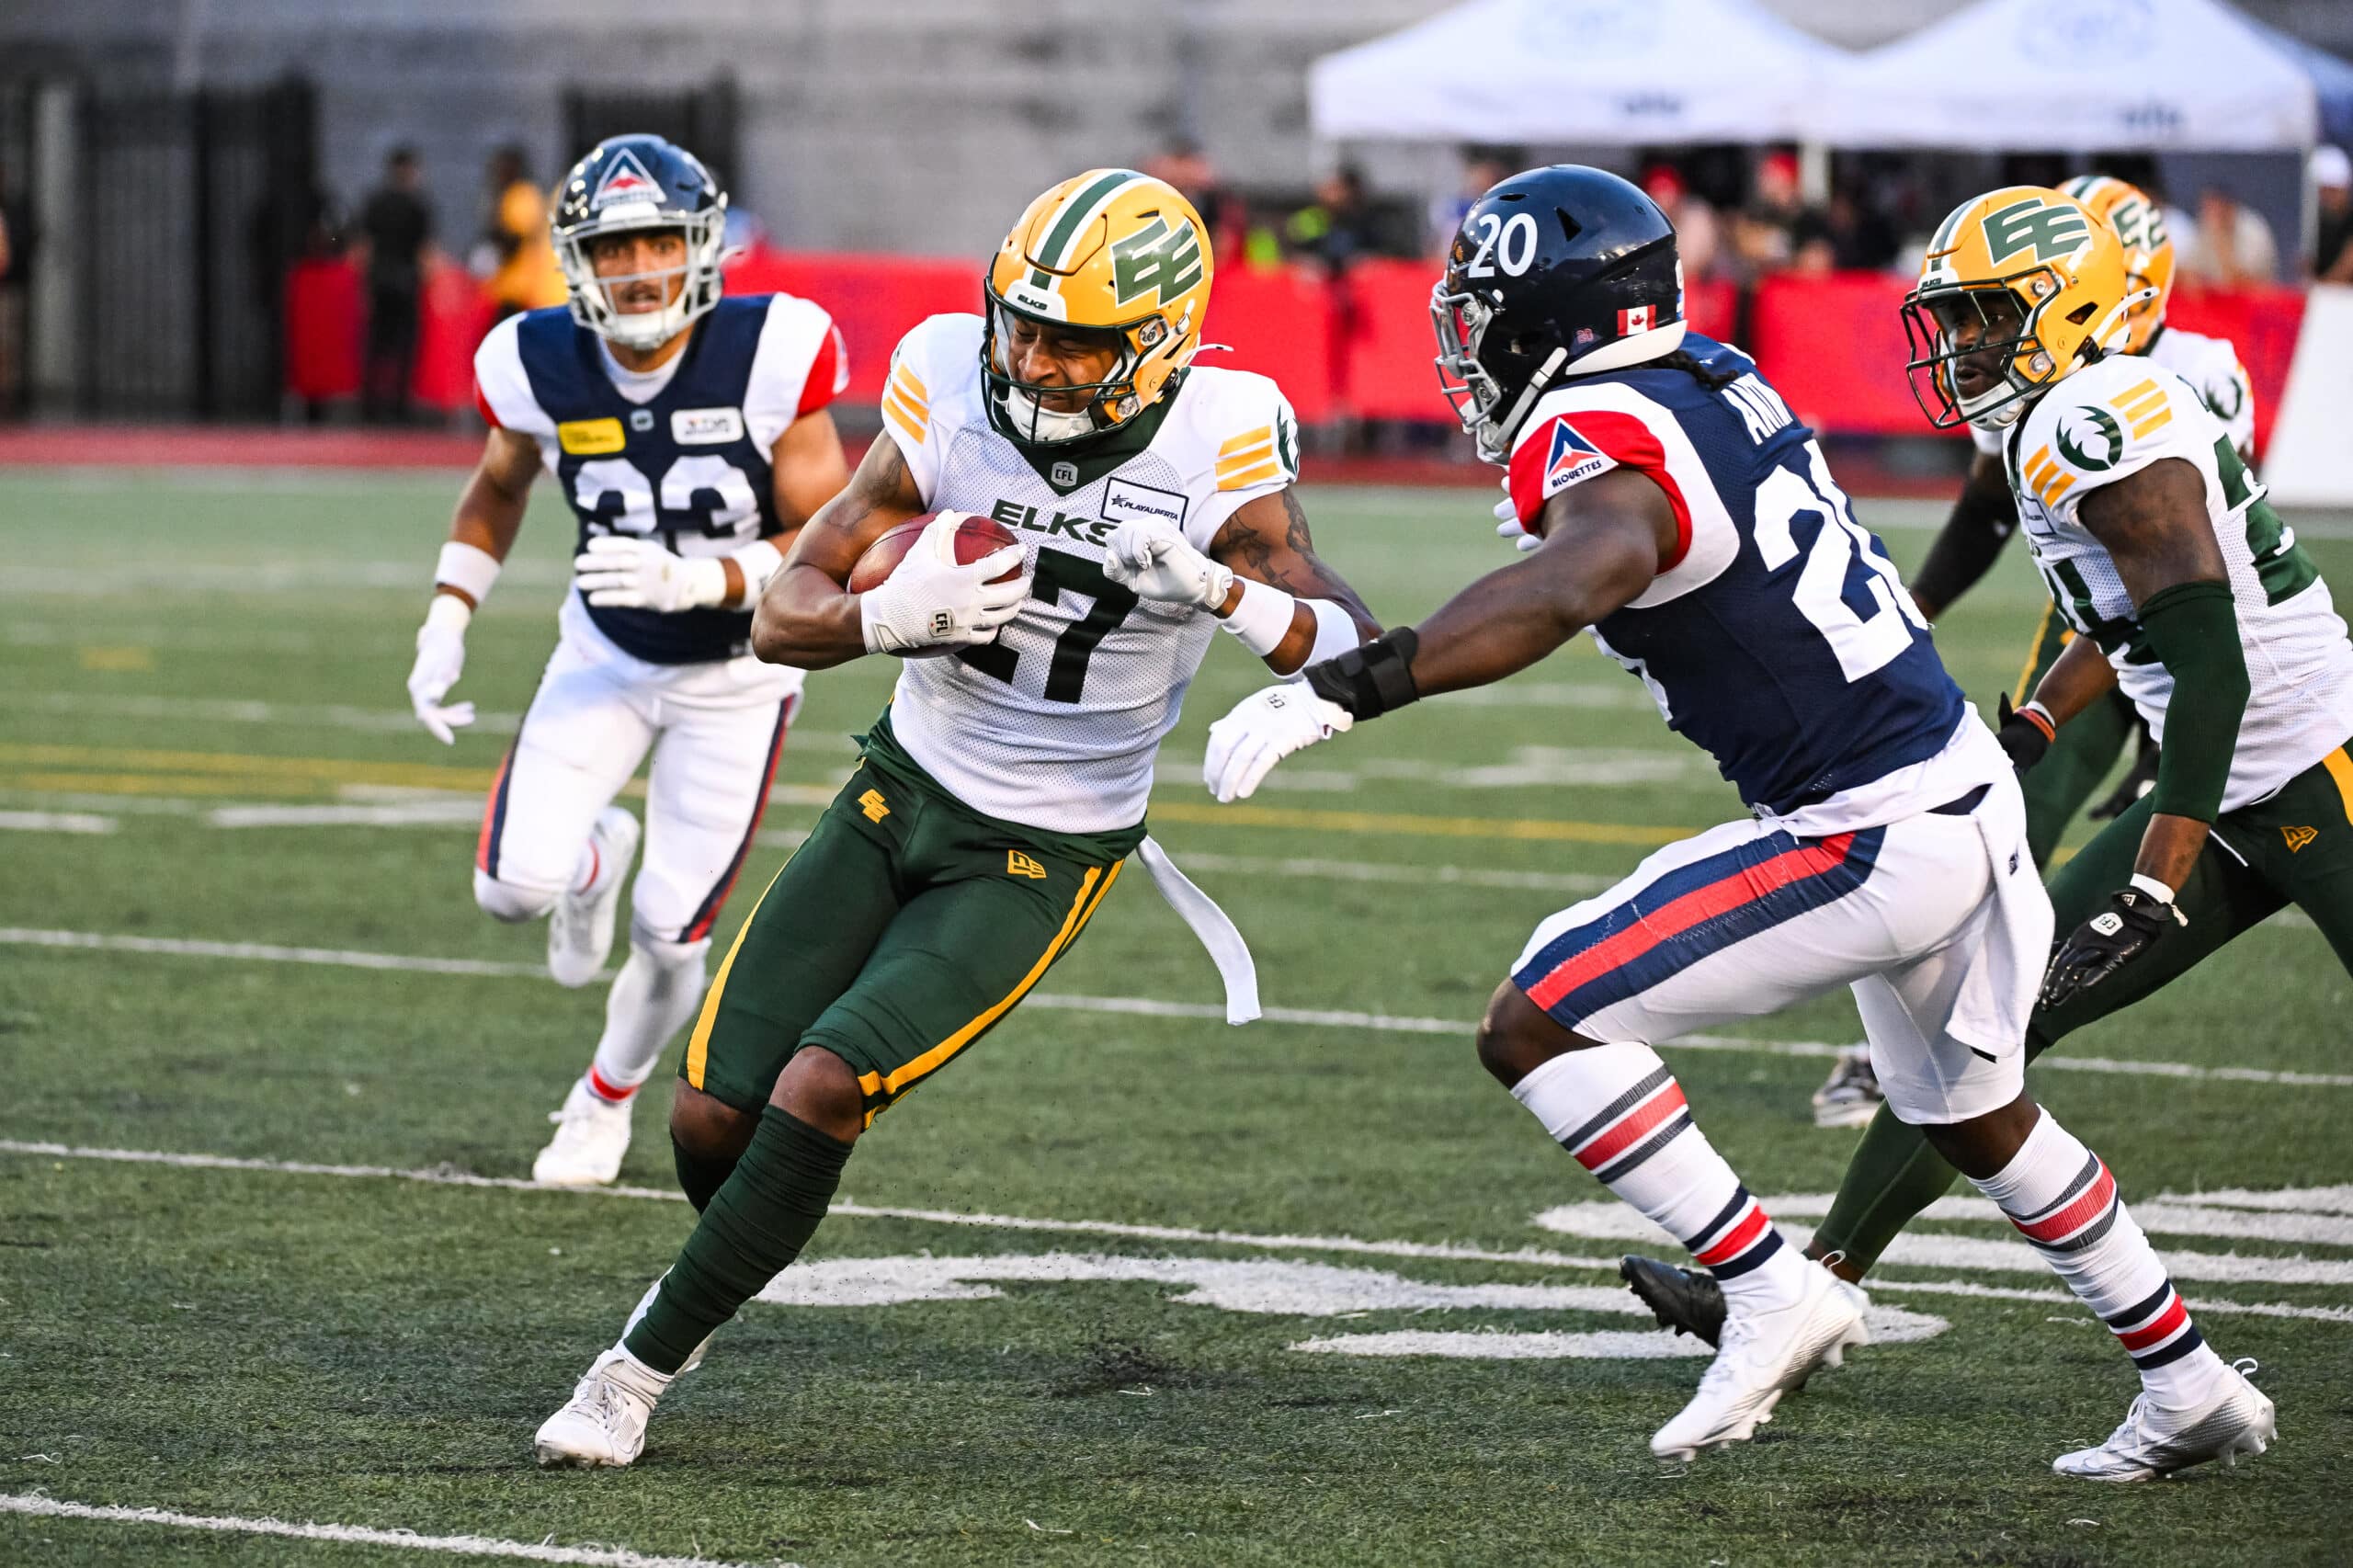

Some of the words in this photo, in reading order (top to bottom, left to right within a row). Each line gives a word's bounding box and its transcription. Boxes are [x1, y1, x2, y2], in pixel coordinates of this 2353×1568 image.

[1468, 212, 1538, 278] 20
[1017, 293, 1048, 311] ELKS
[1055, 469, 1074, 482] CFL
[1552, 460, 1602, 488] ALOUETTES
[990, 499, 1119, 547] ELKS
[935, 613, 949, 633] CFL
